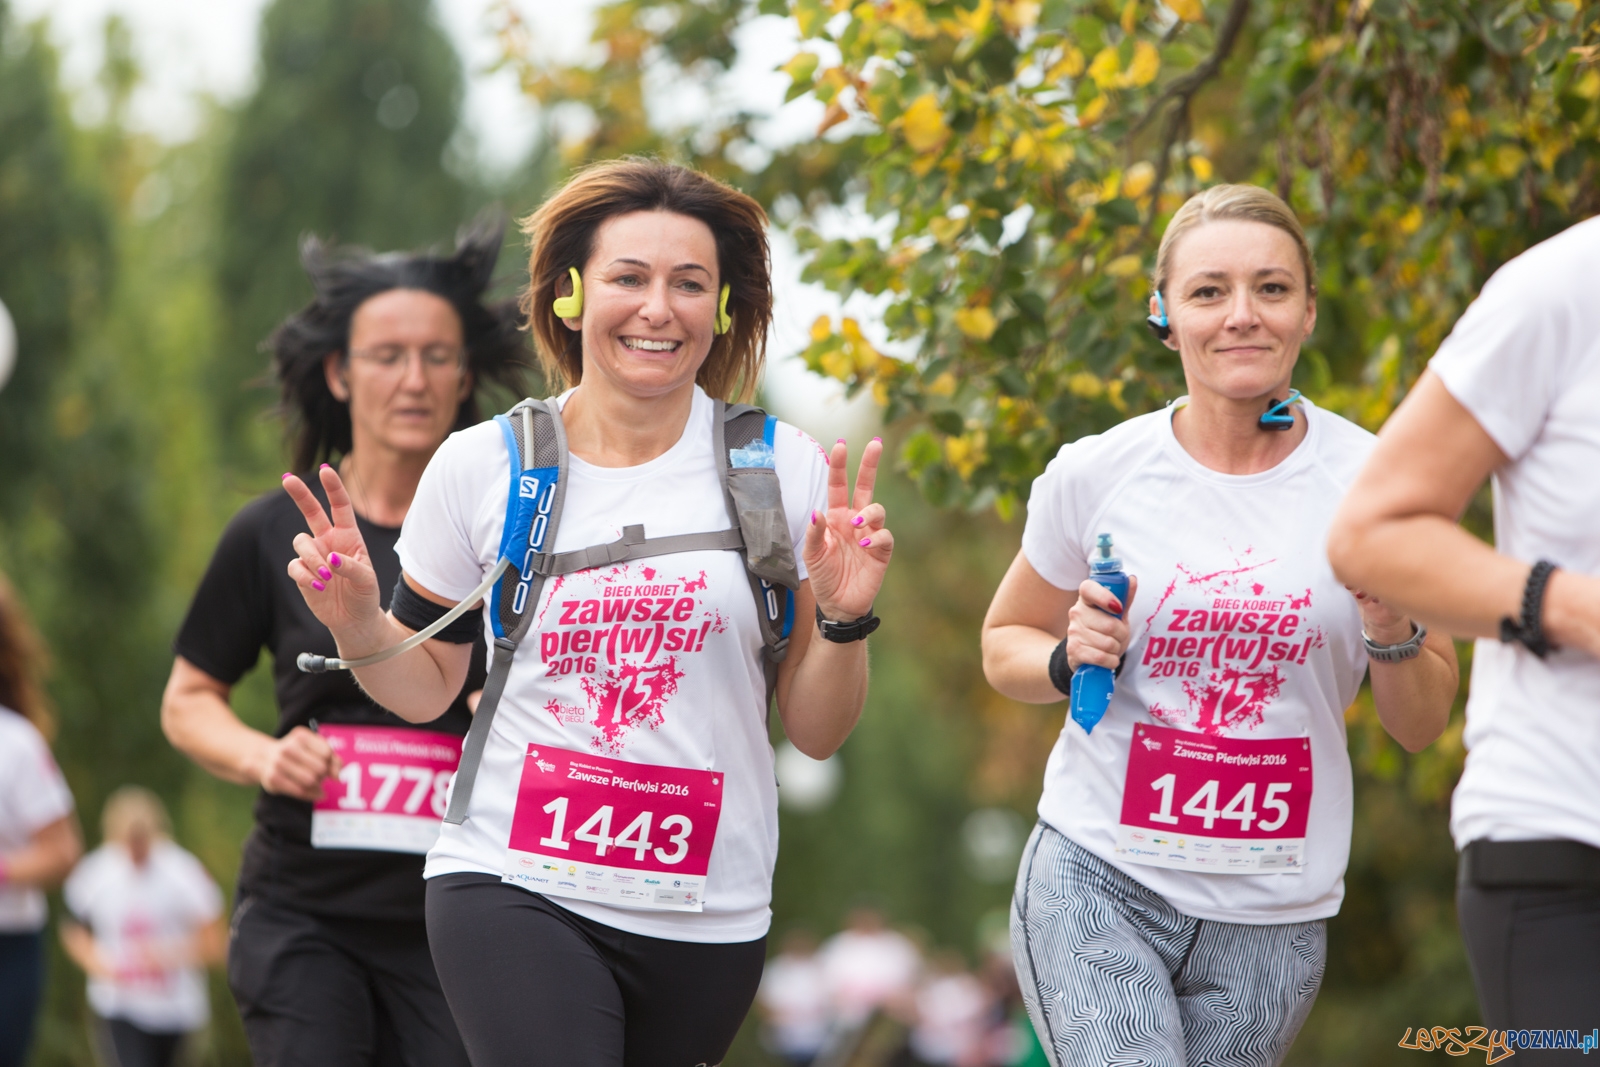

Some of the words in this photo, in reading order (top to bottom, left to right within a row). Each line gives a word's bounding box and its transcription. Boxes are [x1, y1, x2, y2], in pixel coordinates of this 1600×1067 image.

[603, 586, 632, 598] BIEG
[634, 585, 679, 597] KOBIET
[1212, 598, 1241, 610] BIEG
[1242, 600, 1286, 612] KOBIET
[558, 597, 695, 626] zawsze
[1167, 609, 1299, 637] zawsze
[544, 655, 597, 678] 2016
[1149, 660, 1202, 679] 2016
[610, 669, 661, 724] 15
[1212, 675, 1265, 725] 15
[1173, 745, 1214, 762] Zawsze
[1216, 752, 1260, 766] Pier(w)si
[1262, 754, 1288, 766] 2016
[567, 768, 609, 786] Zawsze
[611, 776, 659, 793] Pier(w)si
[661, 783, 690, 796] 2016
[1149, 773, 1293, 832] 1445
[539, 796, 693, 865] 1443
